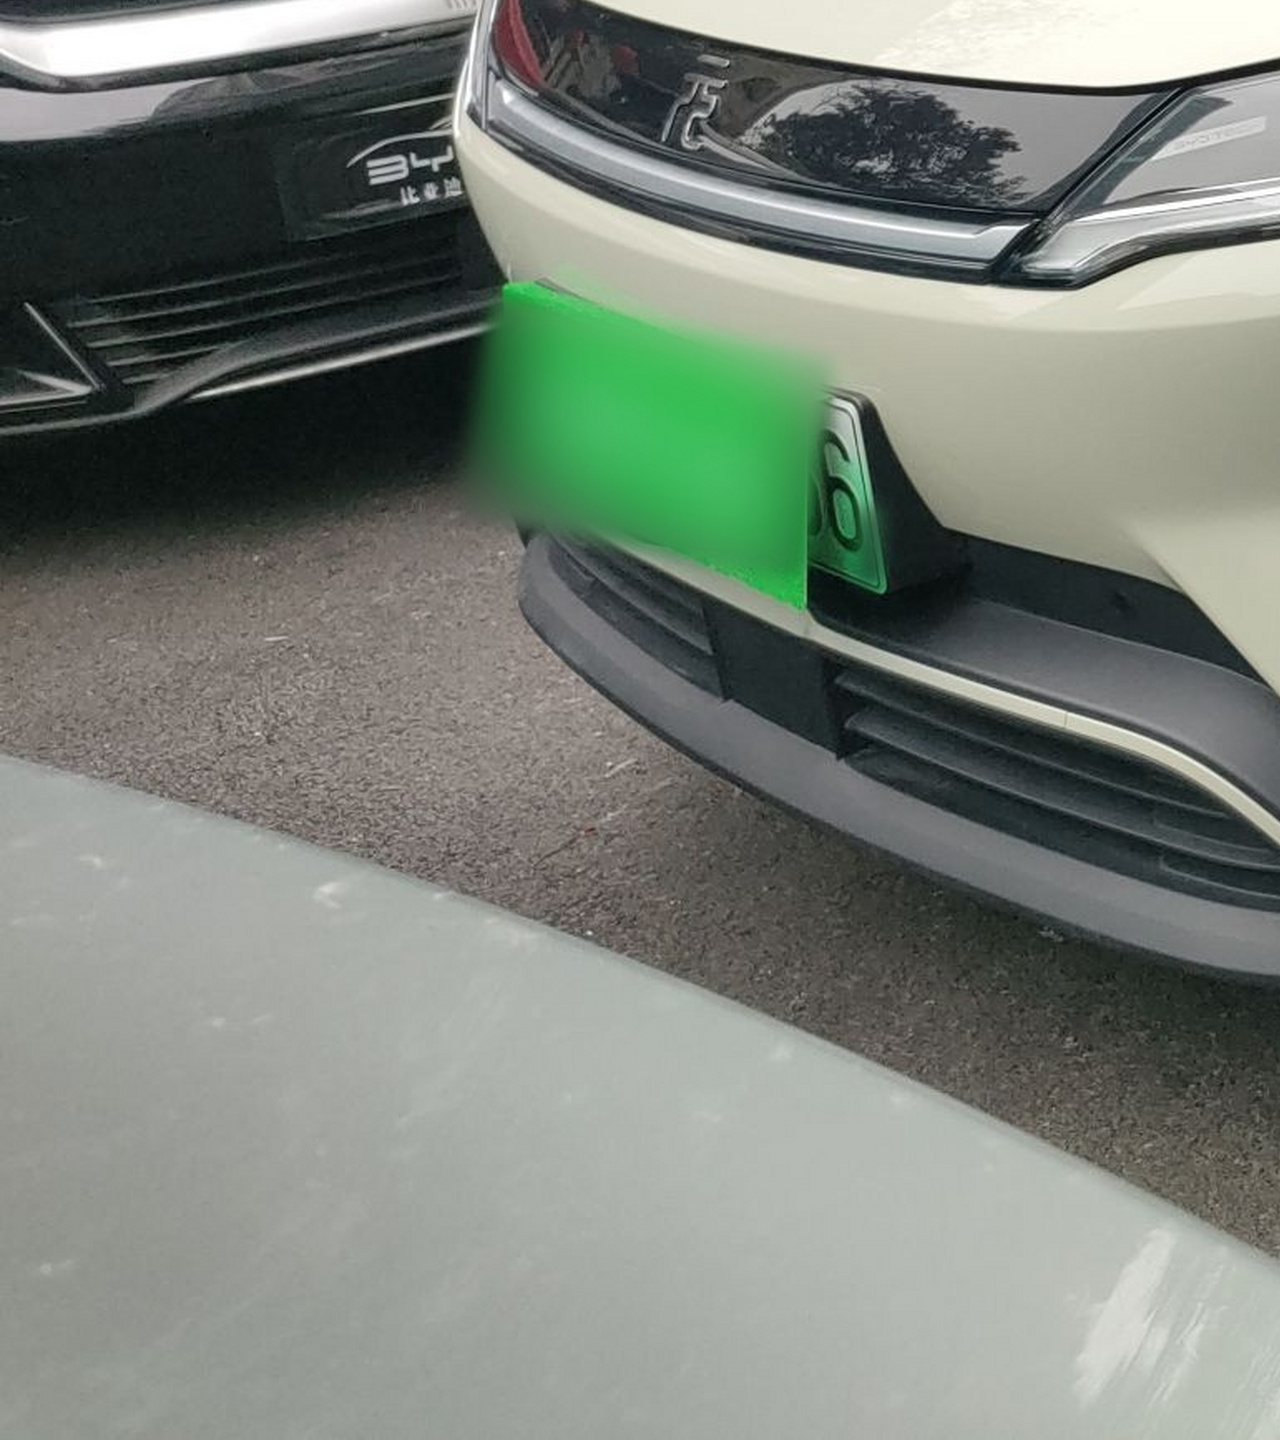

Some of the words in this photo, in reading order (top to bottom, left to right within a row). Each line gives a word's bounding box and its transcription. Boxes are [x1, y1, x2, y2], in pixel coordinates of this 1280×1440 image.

[366, 145, 455, 186] BY
[400, 176, 465, 207] 比亚迪
[812, 427, 864, 552] 6
